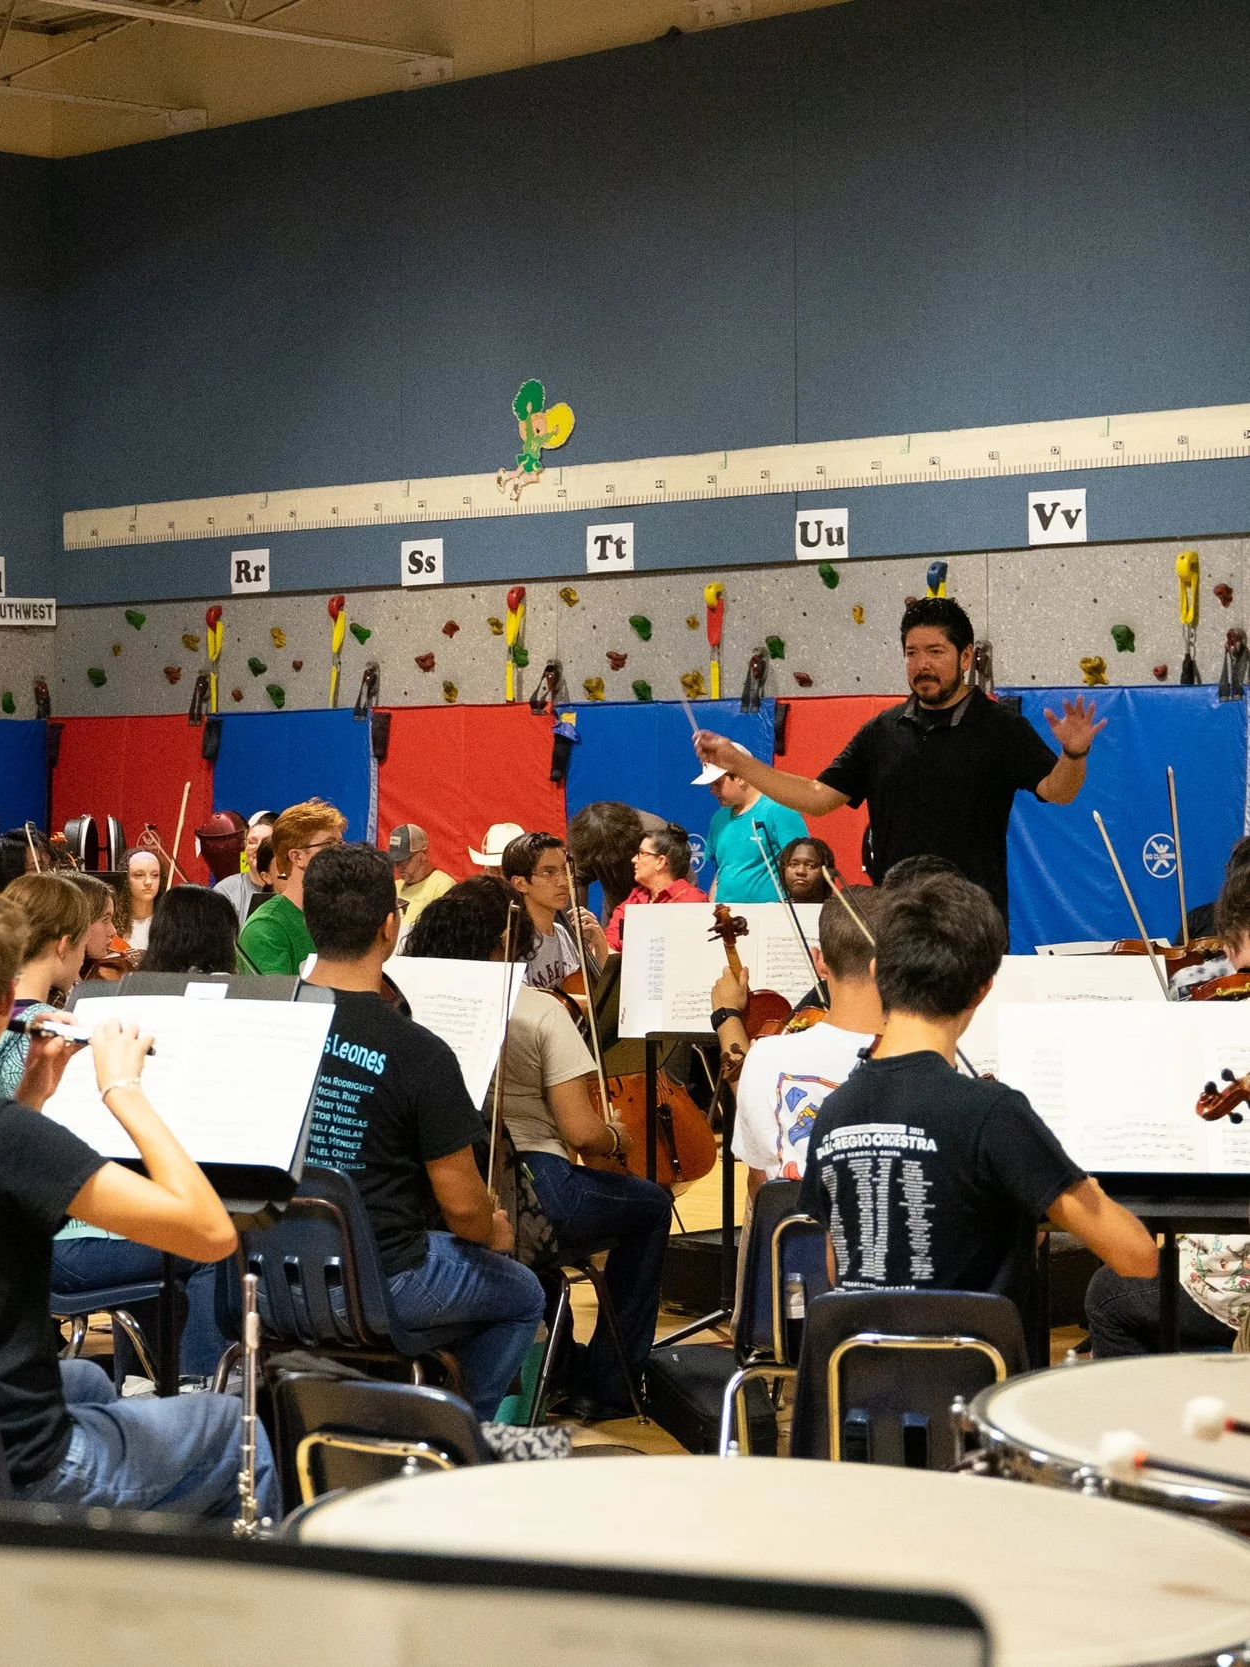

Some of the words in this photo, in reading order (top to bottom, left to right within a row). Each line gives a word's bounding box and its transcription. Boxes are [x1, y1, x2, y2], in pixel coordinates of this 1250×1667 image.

[1033, 502, 1082, 531] Vv
[799, 520, 845, 547] Uu
[594, 534, 627, 560] Tt
[234, 559, 265, 583] Rr
[408, 550, 436, 574] Ss
[332, 1034, 386, 1075] Leones
